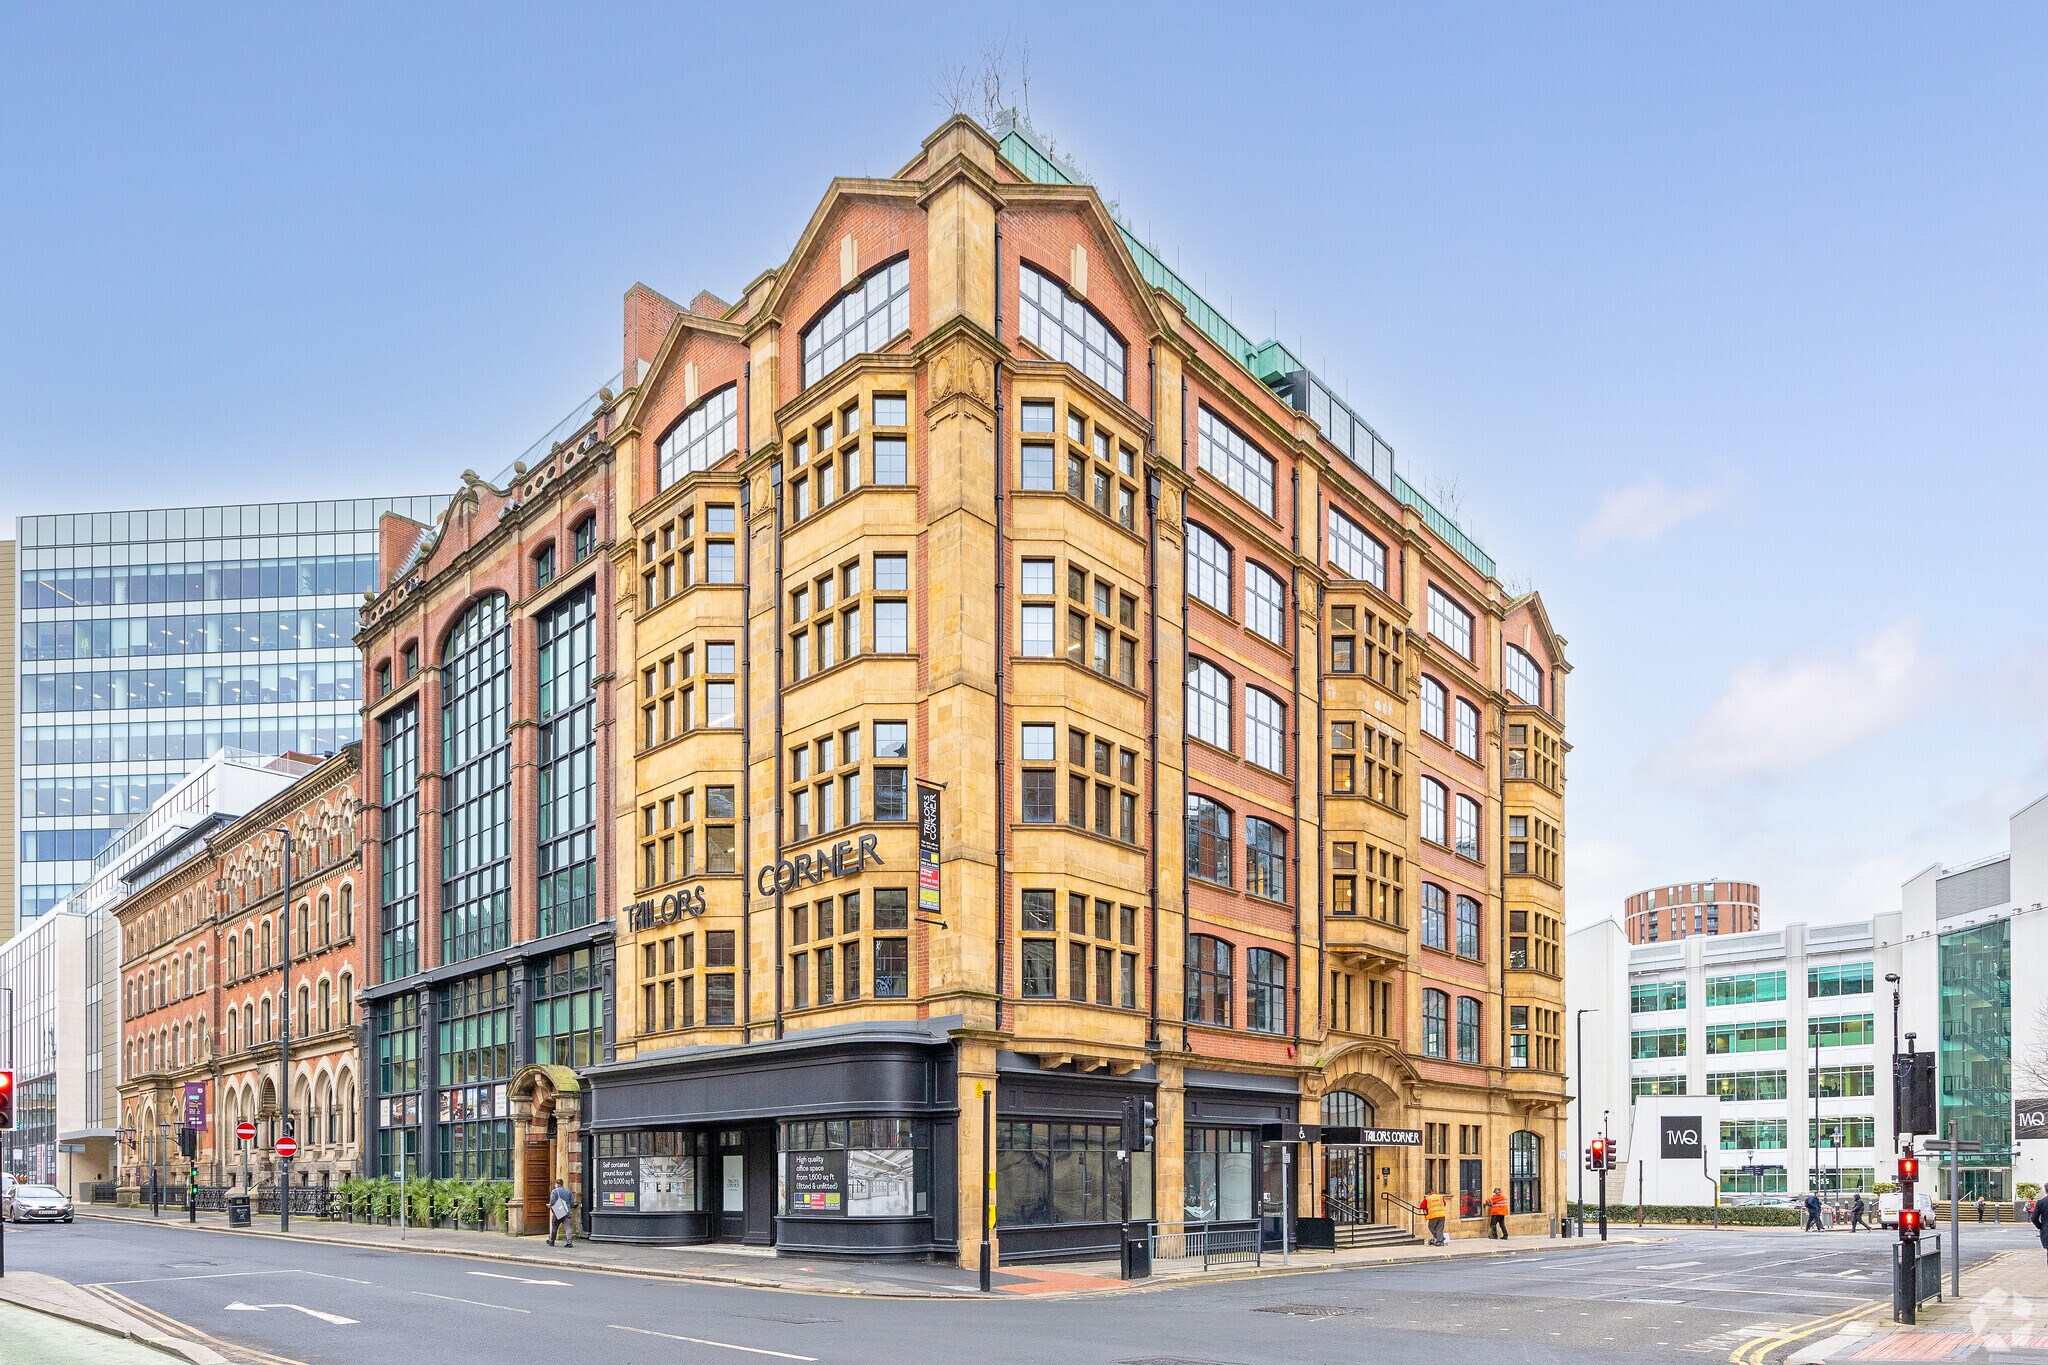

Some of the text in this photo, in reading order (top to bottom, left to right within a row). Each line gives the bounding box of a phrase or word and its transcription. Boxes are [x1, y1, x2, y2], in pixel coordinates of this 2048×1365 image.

[758, 834, 885, 896] CORNER
[623, 885, 706, 932] TAILORS
[2018, 1112, 2046, 1127] 1WQ
[1364, 1130, 1419, 1143] TAILORS CORNER
[1667, 1129, 1699, 1145] 1WQ
[796, 1155, 824, 1164] High quality
[603, 1170, 616, 1178] ground
[812, 1182, 817, 1190] &
